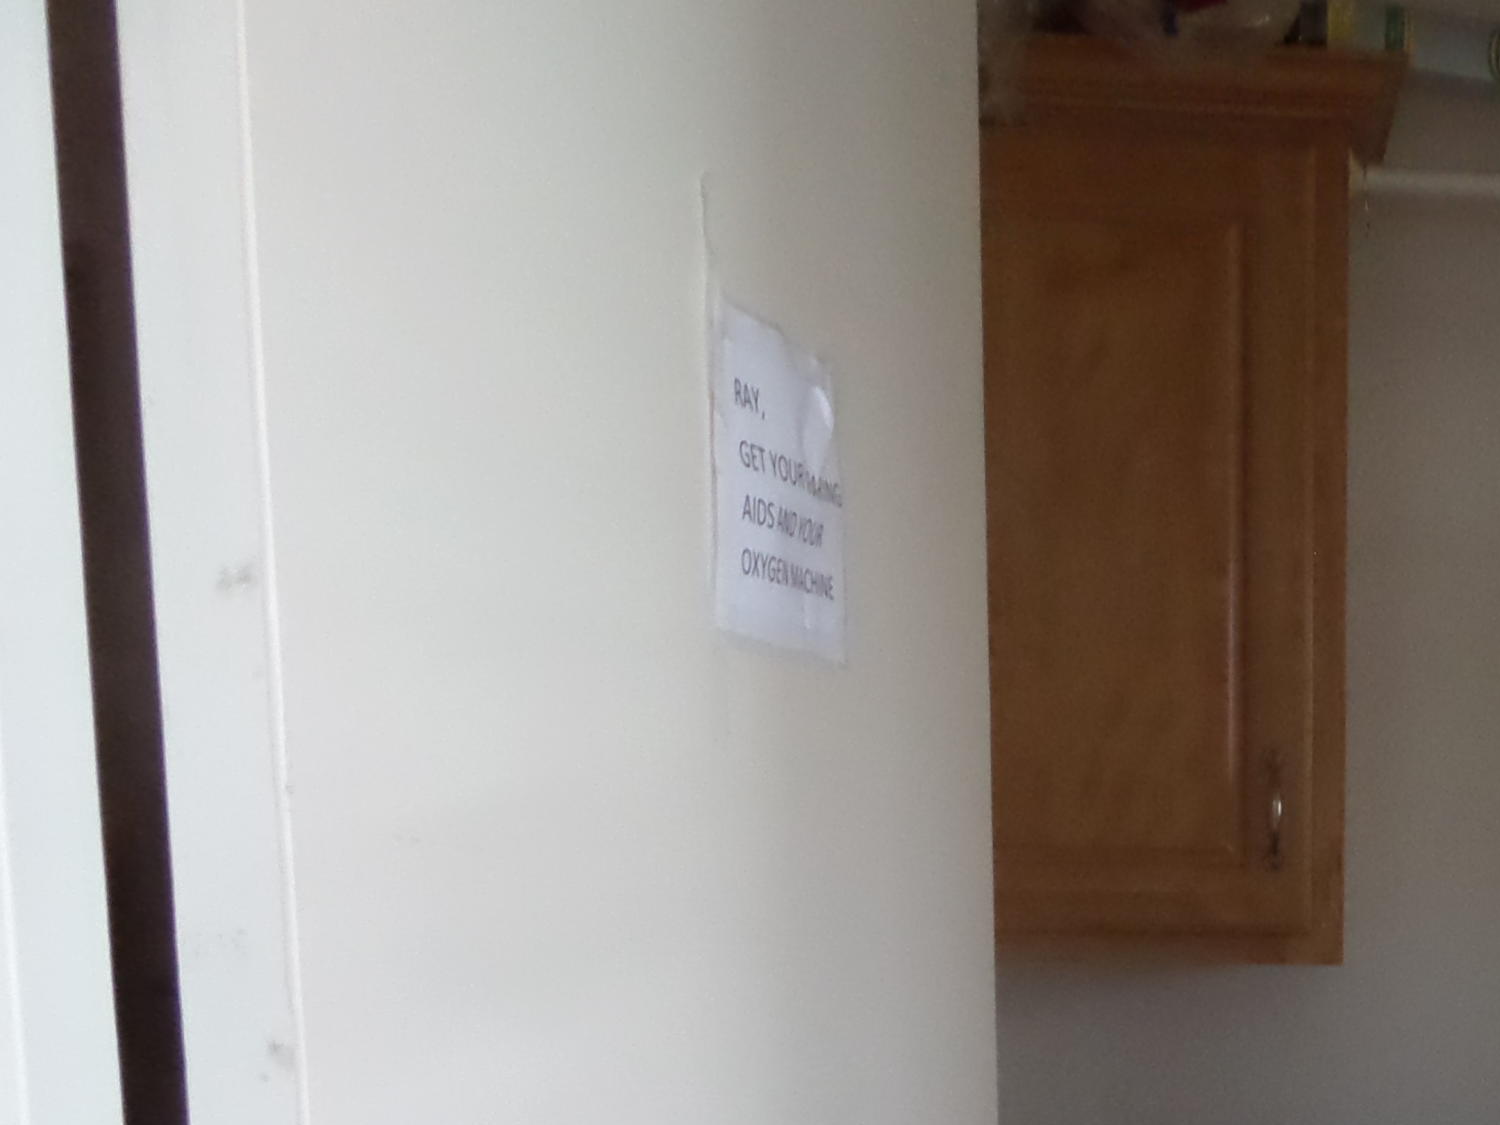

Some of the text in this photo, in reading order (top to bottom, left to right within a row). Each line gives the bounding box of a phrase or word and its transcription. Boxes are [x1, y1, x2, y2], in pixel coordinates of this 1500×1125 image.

[734, 377, 765, 420] RAY,
[739, 440, 766, 474] GET
[769, 449, 806, 489] YOUR
[742, 494, 824, 548] AIDS AND YOUR
[741, 547, 834, 601] OXYGEN MACHINE
